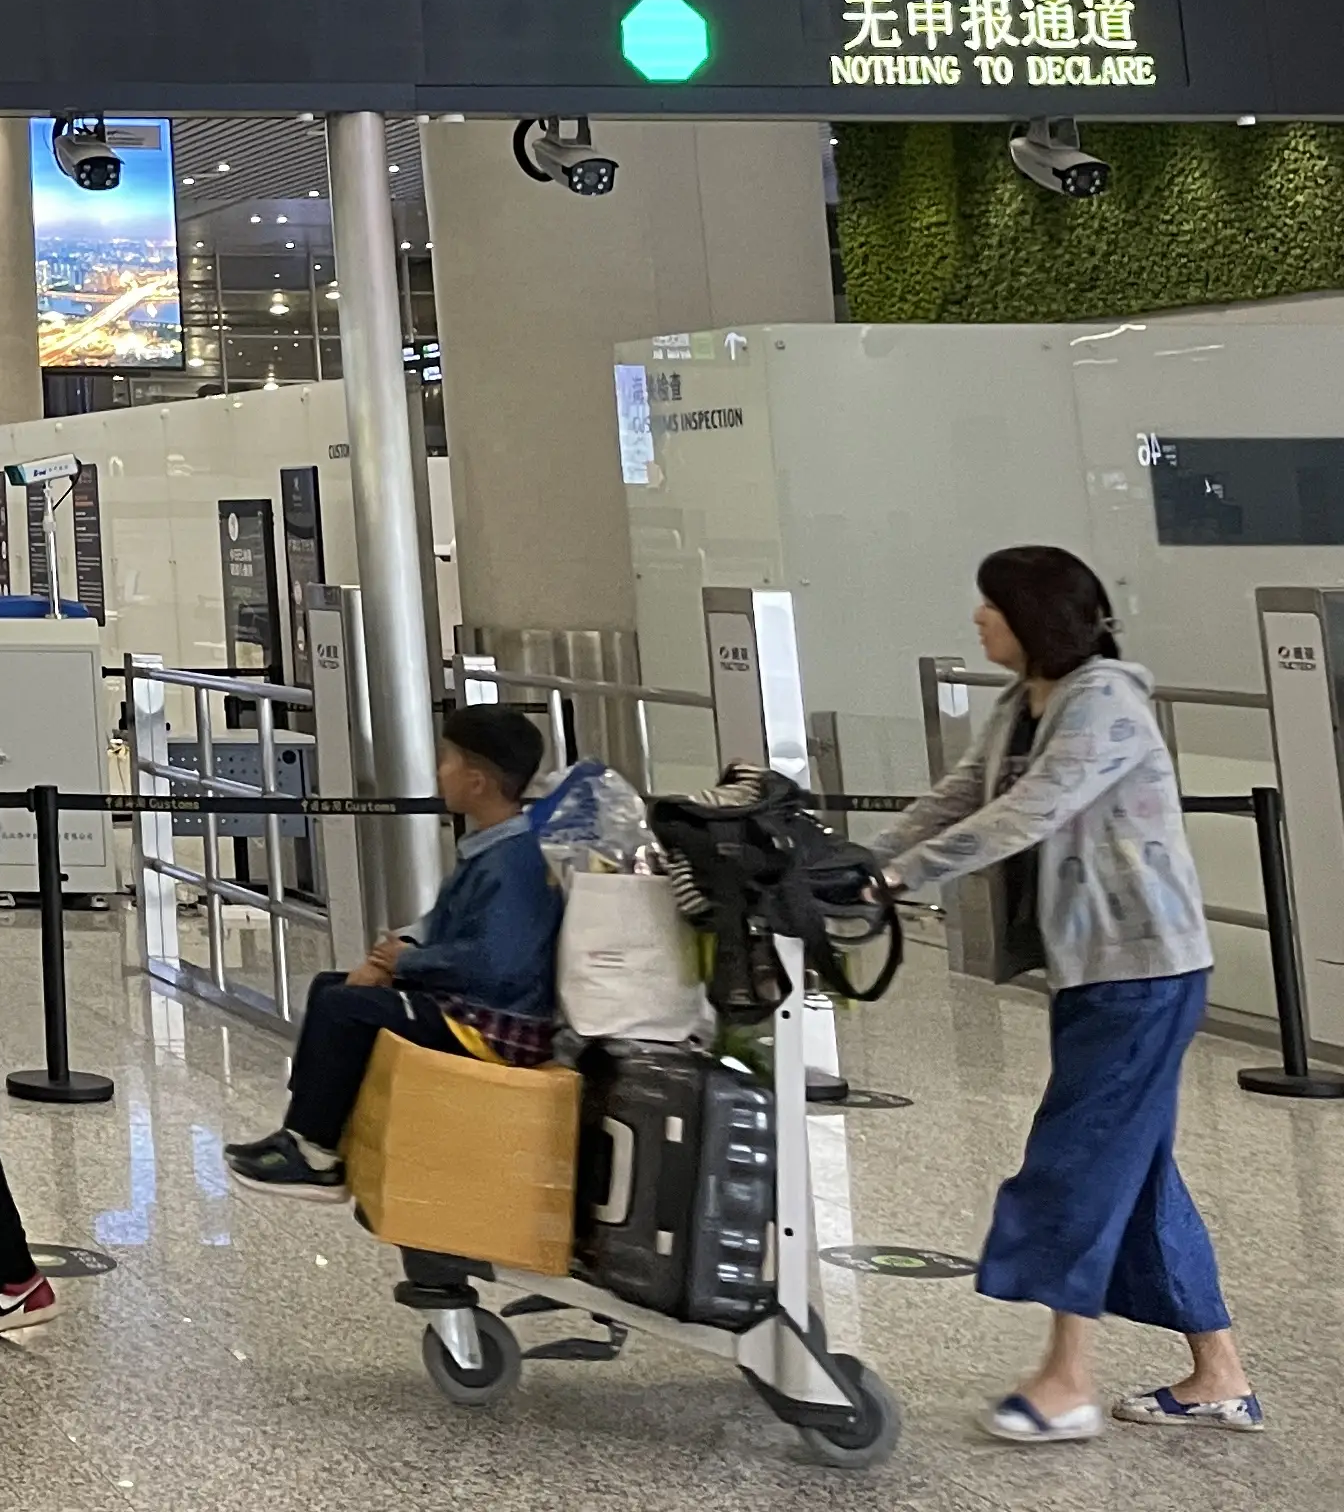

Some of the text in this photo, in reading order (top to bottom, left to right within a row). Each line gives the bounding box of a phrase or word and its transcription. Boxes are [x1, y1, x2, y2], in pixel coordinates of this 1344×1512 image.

[829, 55, 1157, 87] NOTHING TO DECLARE
[680, 407, 744, 432] INSPECTION
